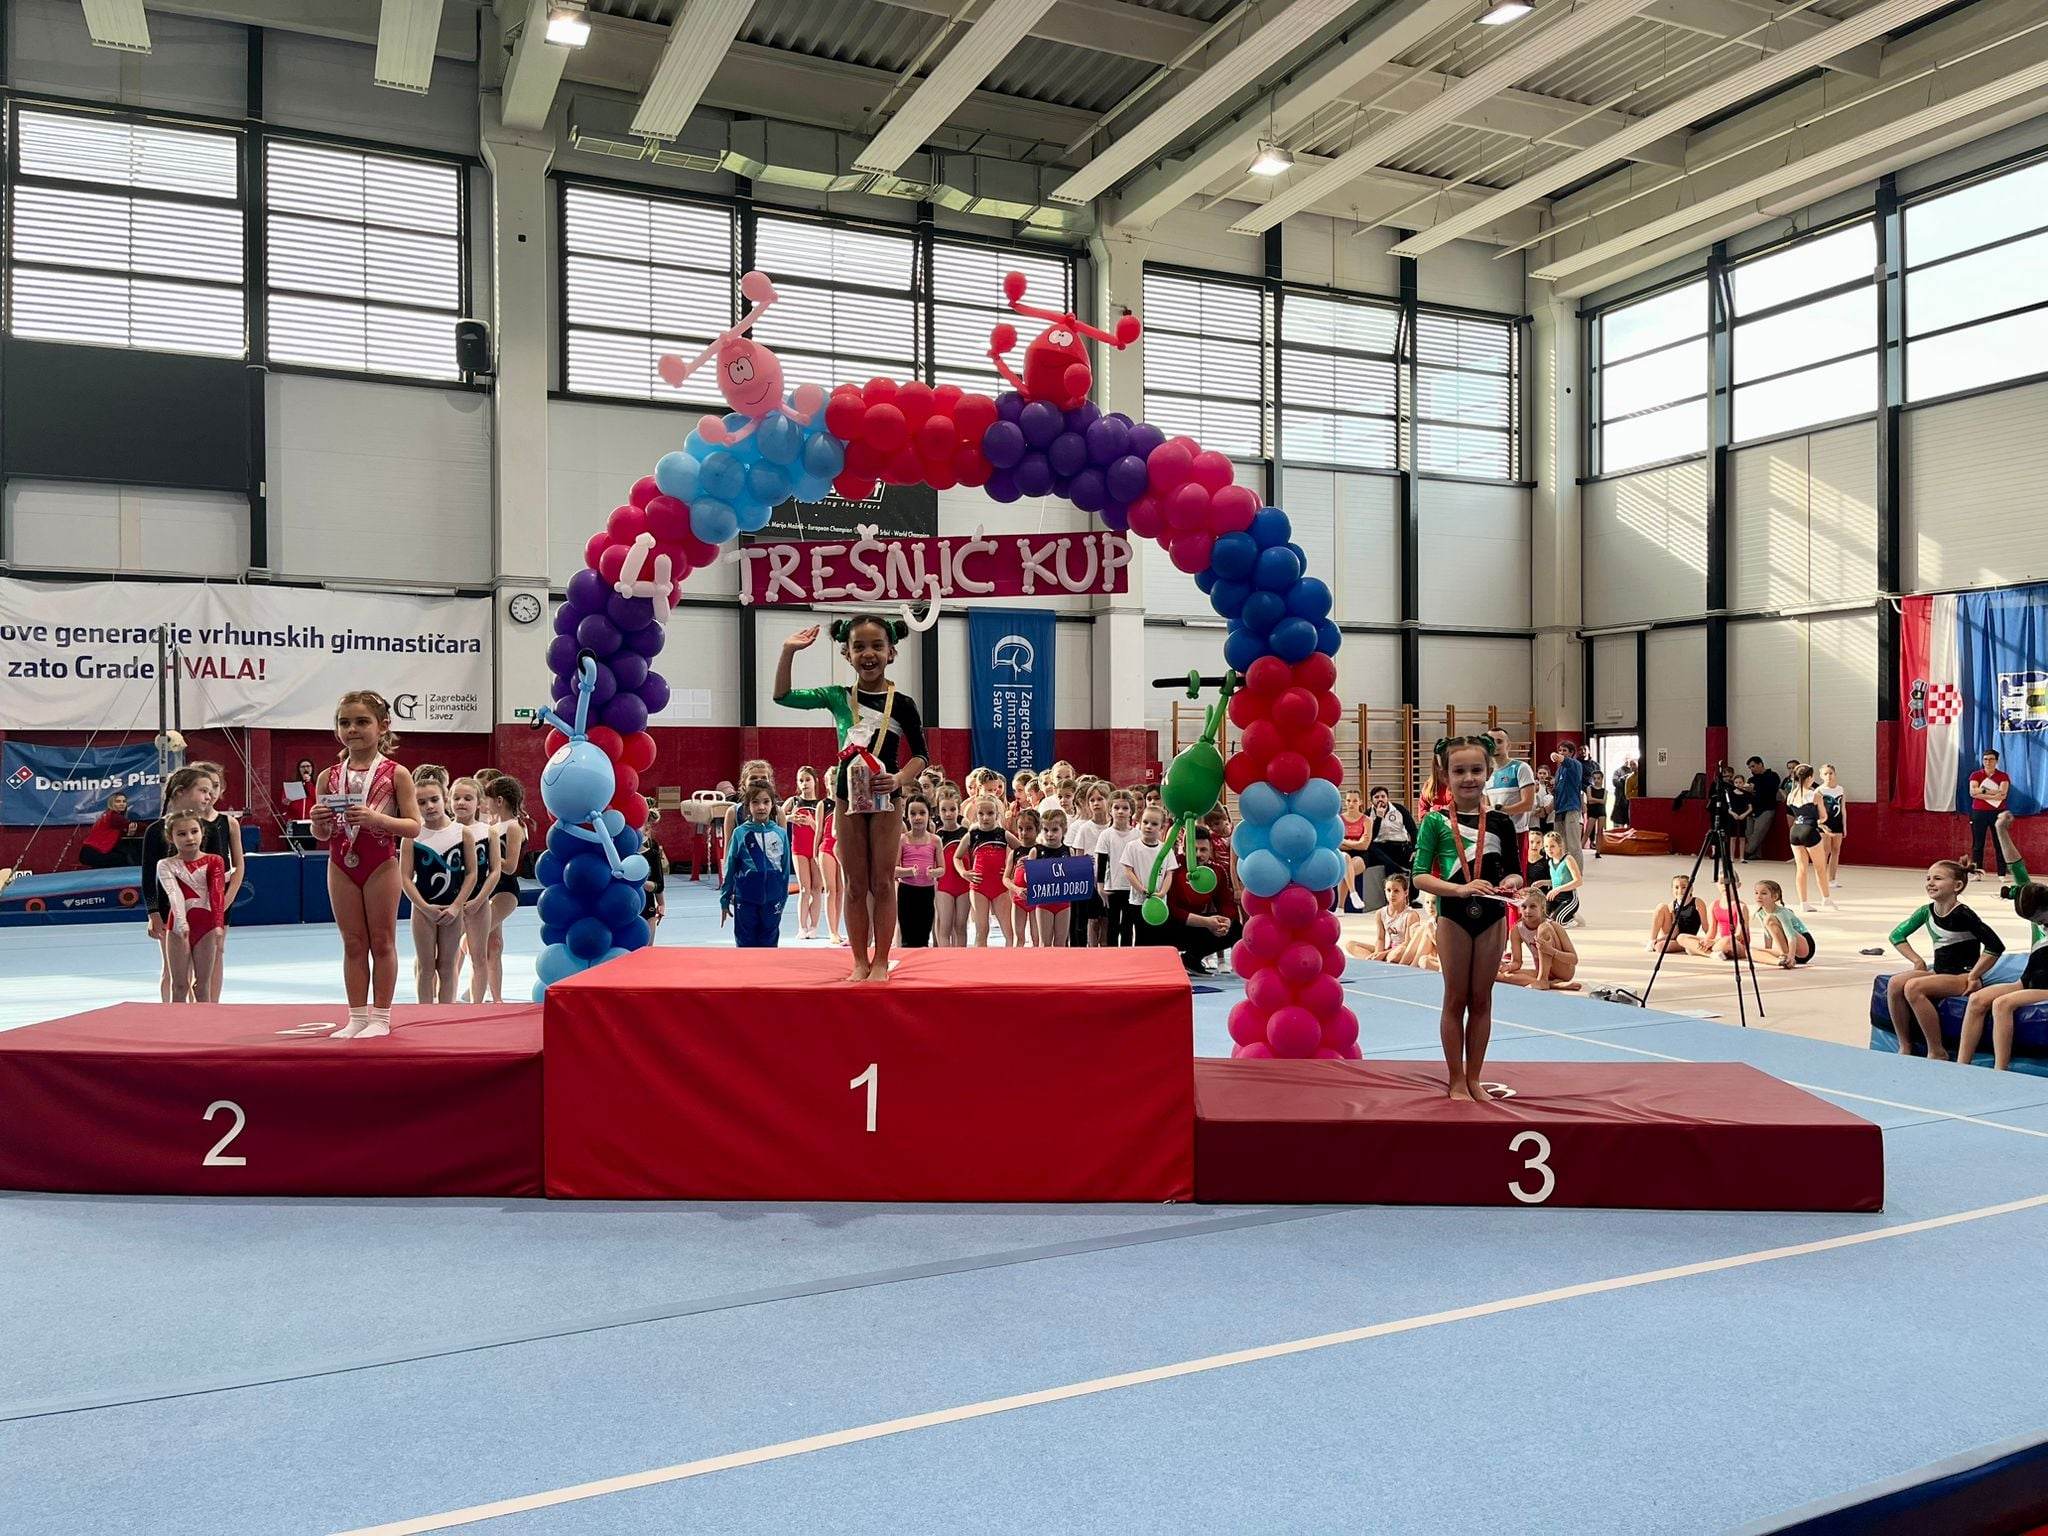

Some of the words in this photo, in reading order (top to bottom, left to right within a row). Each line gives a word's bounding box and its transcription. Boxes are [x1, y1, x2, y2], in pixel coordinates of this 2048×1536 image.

[614, 532, 673, 625] 4
[1017, 532, 1133, 594] KUP
[55, 622, 192, 648] generacije
[199, 622, 324, 648] vrhunskih
[331, 629, 481, 653] gimnastičara
[8, 658, 68, 679] zato
[75, 655, 154, 679] Grade
[164, 656, 266, 681] HVALA!
[430, 693, 478, 703] Zagrebački
[430, 703, 478, 712] gimnastički
[993, 691, 1003, 728] savez
[430, 712, 453, 720] savez
[1005, 691, 1018, 769] gimnastički
[1018, 691, 1033, 768] Zagrebački
[35, 774, 123, 791] Domino's
[128, 771, 160, 786] Pizz
[75, 896, 105, 906] SPIETH
[1032, 882, 1060, 898] SPARTA
[1063, 881, 1089, 895] DOBOJ
[849, 1064, 878, 1133] 1
[202, 1099, 247, 1166] 2
[1508, 1131, 1555, 1203] 3
